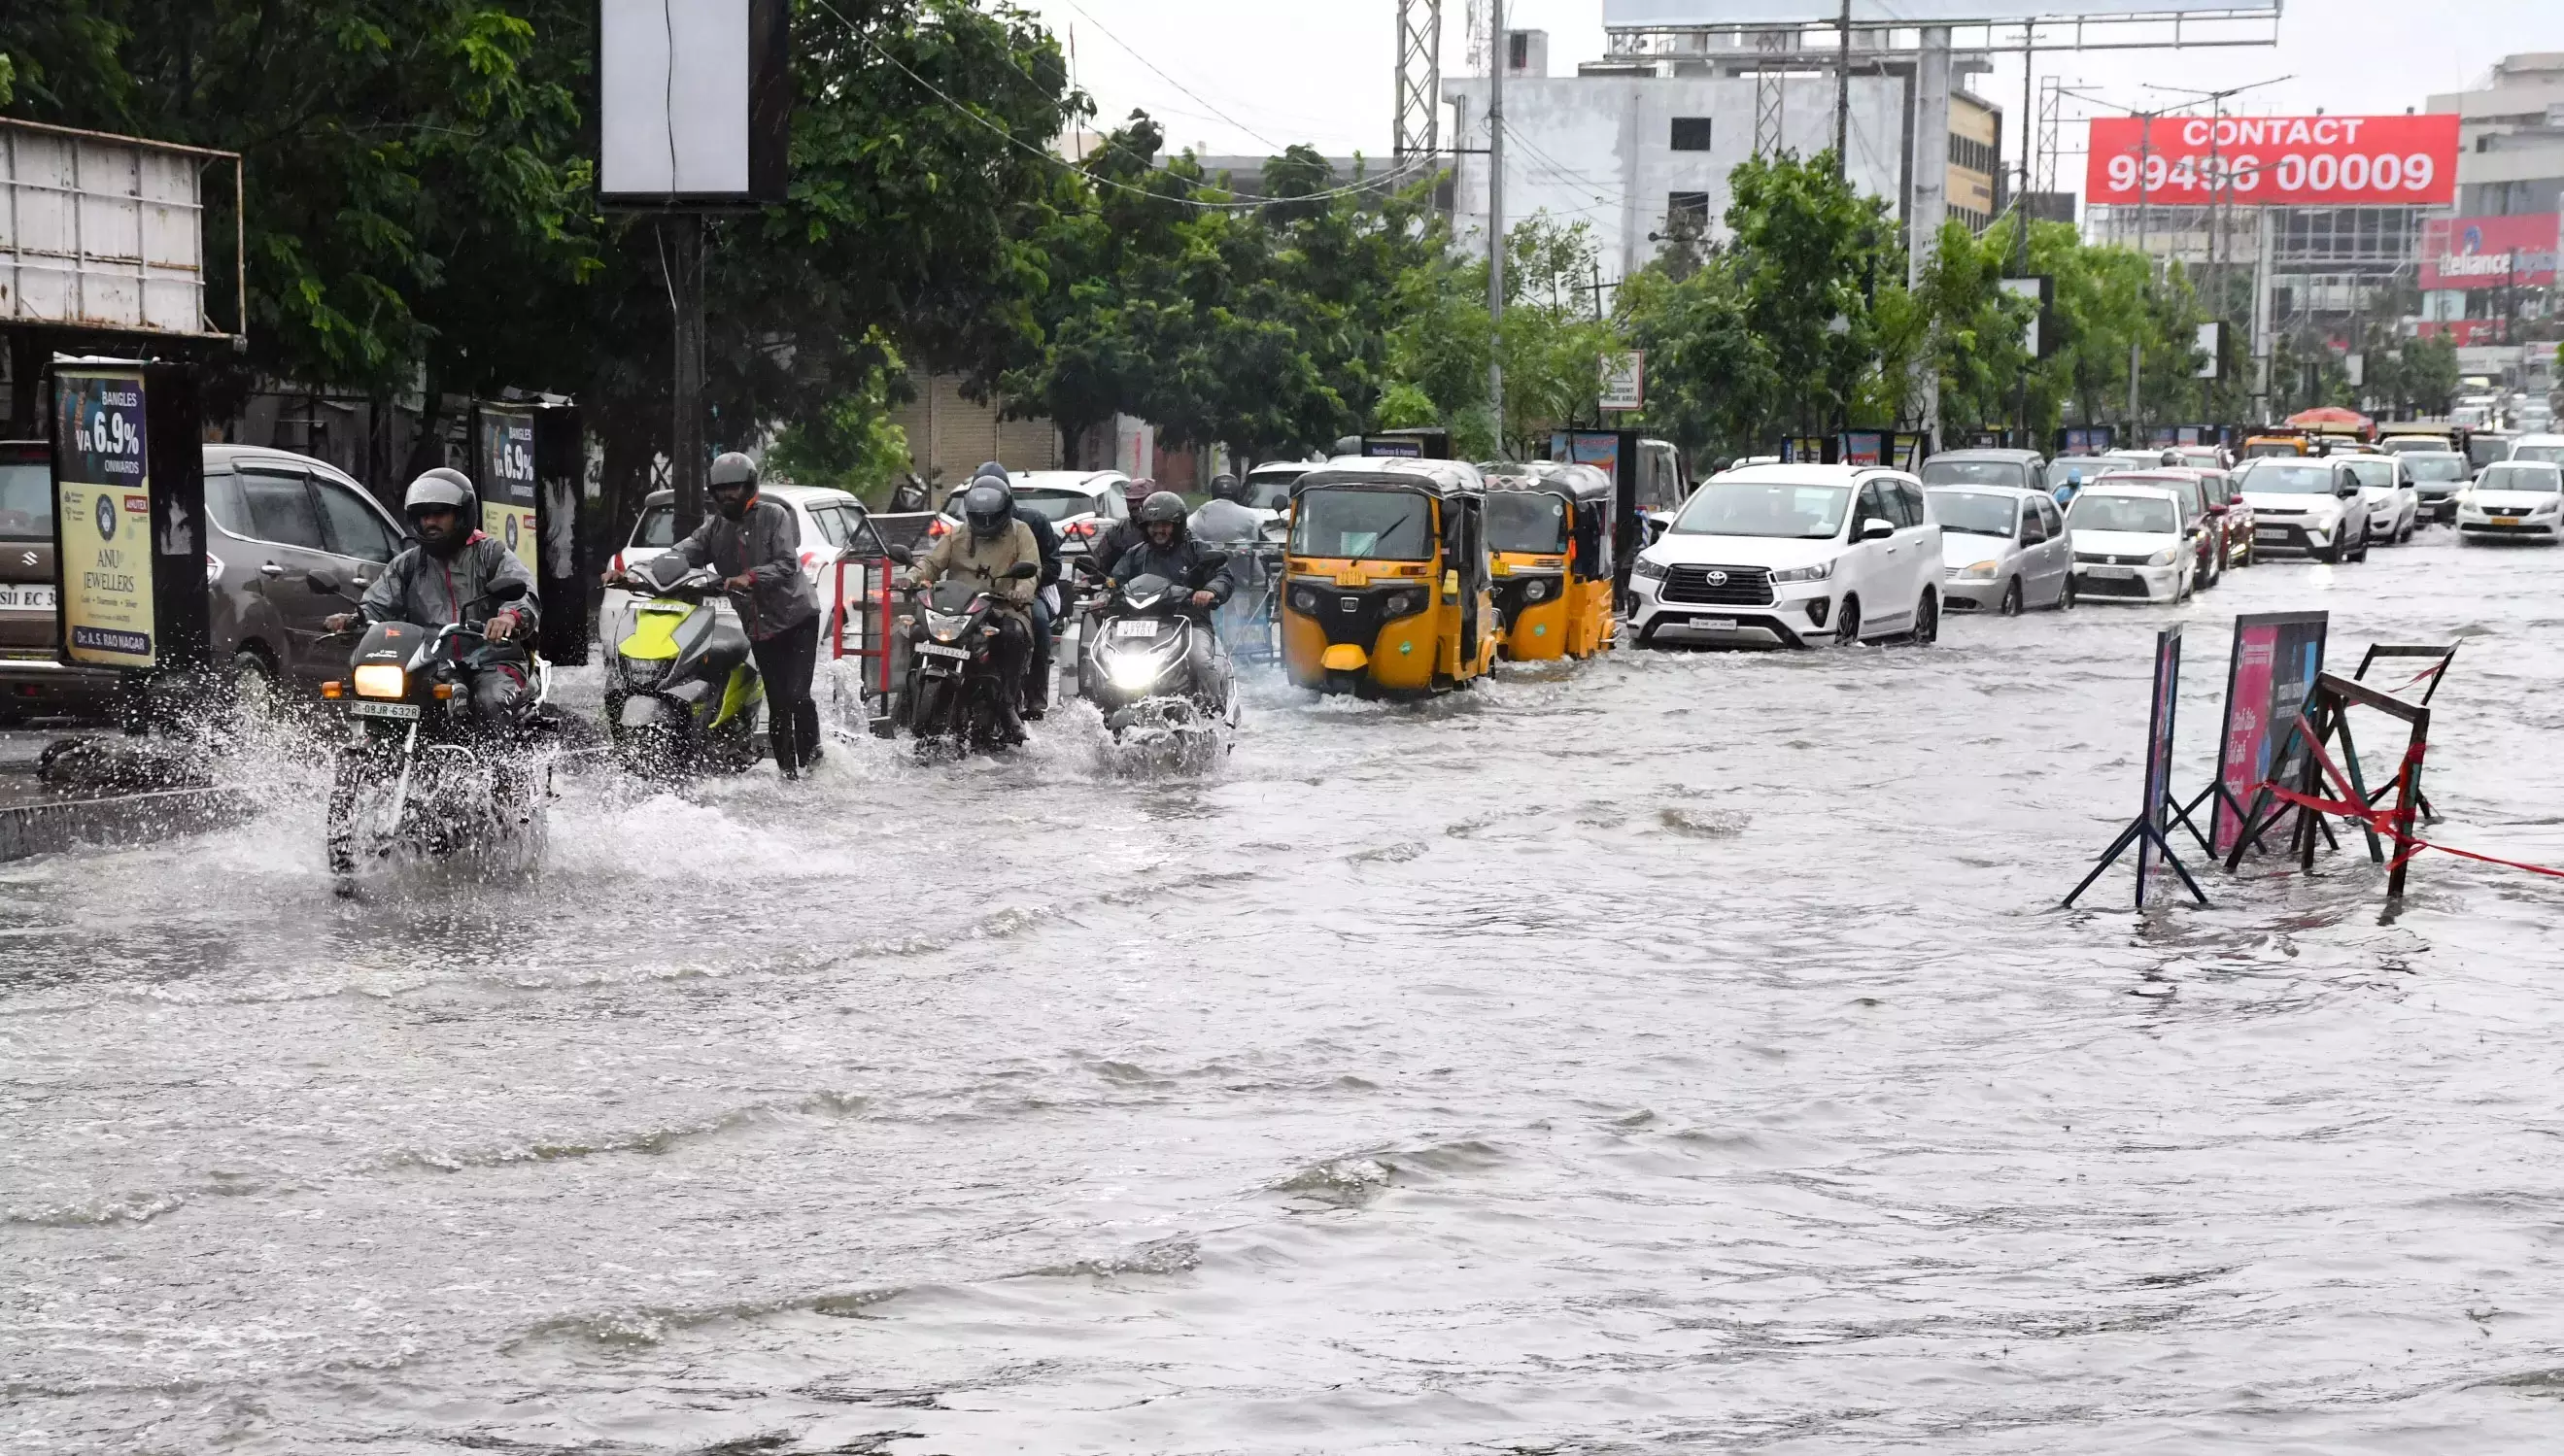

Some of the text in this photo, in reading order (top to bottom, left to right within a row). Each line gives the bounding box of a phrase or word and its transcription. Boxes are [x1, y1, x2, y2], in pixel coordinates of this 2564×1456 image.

[2183, 119, 2364, 146] CONTACT
[2107, 153, 2434, 192] 99496 00009
[2439, 243, 2512, 277] Reliance
[102, 391, 137, 407] BANGLES
[76, 411, 139, 455] VA 6.9%
[509, 427, 531, 441] BANGLES
[104, 459, 139, 474] ONWARDS
[494, 443, 533, 481] VA 6.9%
[96, 549, 119, 568] ANU
[84, 571, 134, 593] JEWELLERS
[24, 592, 43, 605] EC
[77, 631, 145, 650] Dr. A. S. RAO NAGAR
